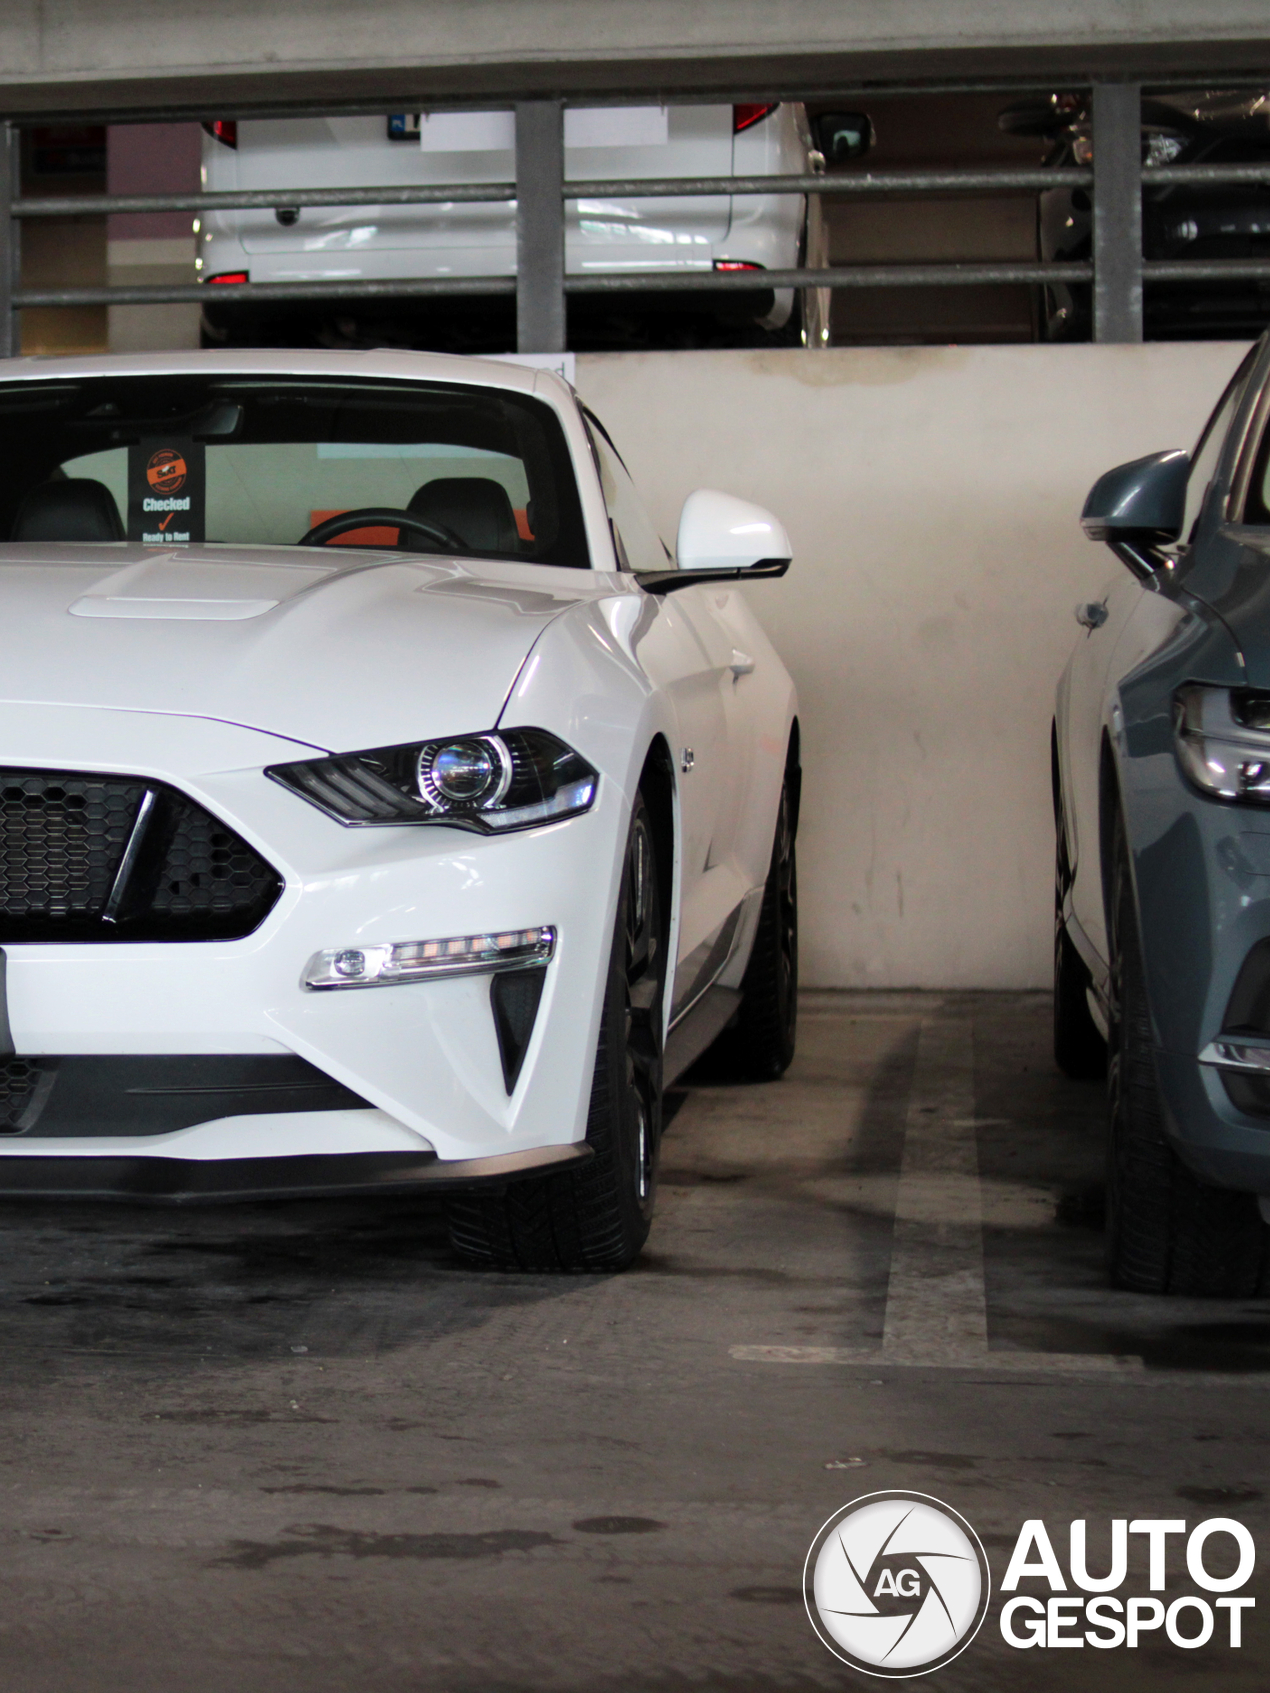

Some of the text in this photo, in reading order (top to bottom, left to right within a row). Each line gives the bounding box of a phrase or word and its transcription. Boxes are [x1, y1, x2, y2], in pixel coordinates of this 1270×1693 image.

[142, 496, 190, 512] Checked
[142, 531, 190, 543] Ready to Rent
